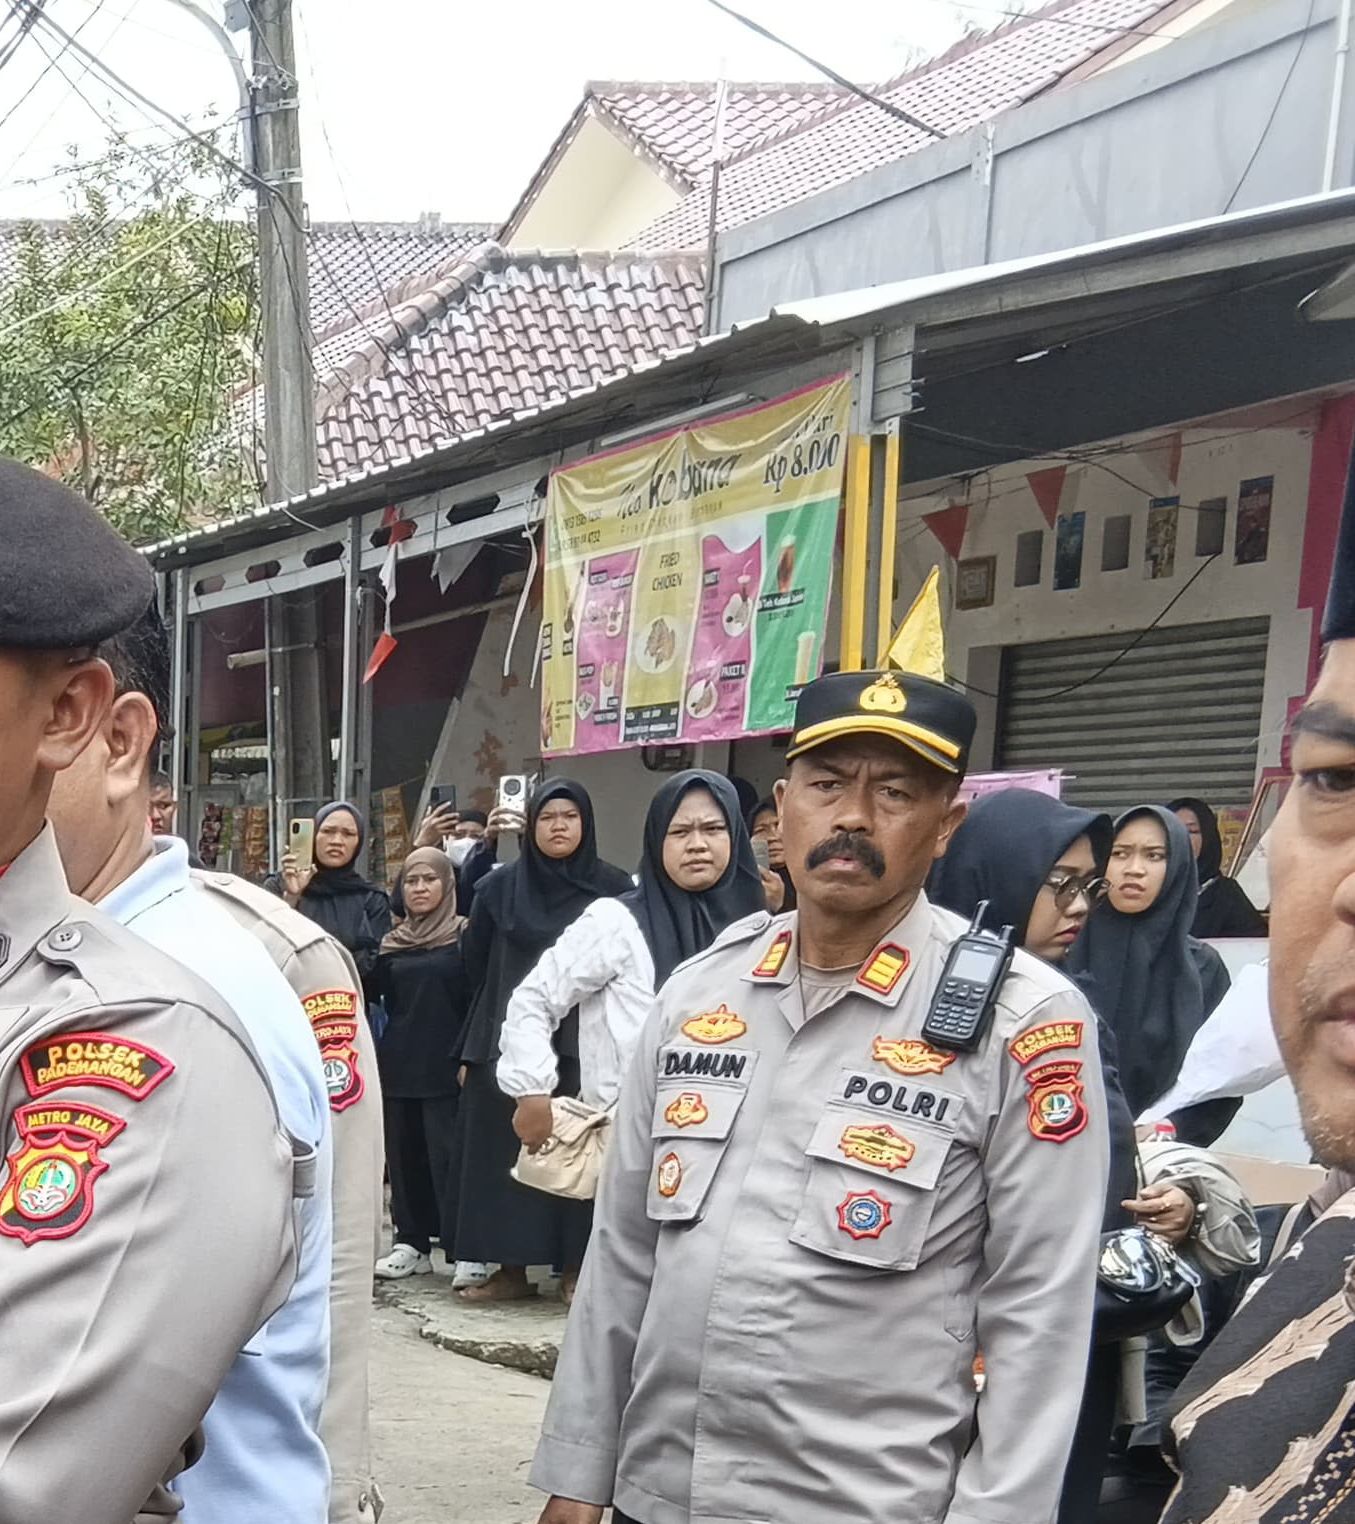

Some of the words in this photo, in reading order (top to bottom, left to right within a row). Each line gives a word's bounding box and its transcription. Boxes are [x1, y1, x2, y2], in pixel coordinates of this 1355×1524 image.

[305, 993, 351, 1010] OLSEK
[1015, 1024, 1076, 1053] POLSEK
[47, 1042, 145, 1067] POLSEK
[664, 1051, 747, 1079] DAMUN
[37, 1059, 146, 1087] PADEMANGAN
[843, 1075, 950, 1121] POLRI
[27, 1111, 71, 1129] METRO
[75, 1112, 111, 1135] JAYA
